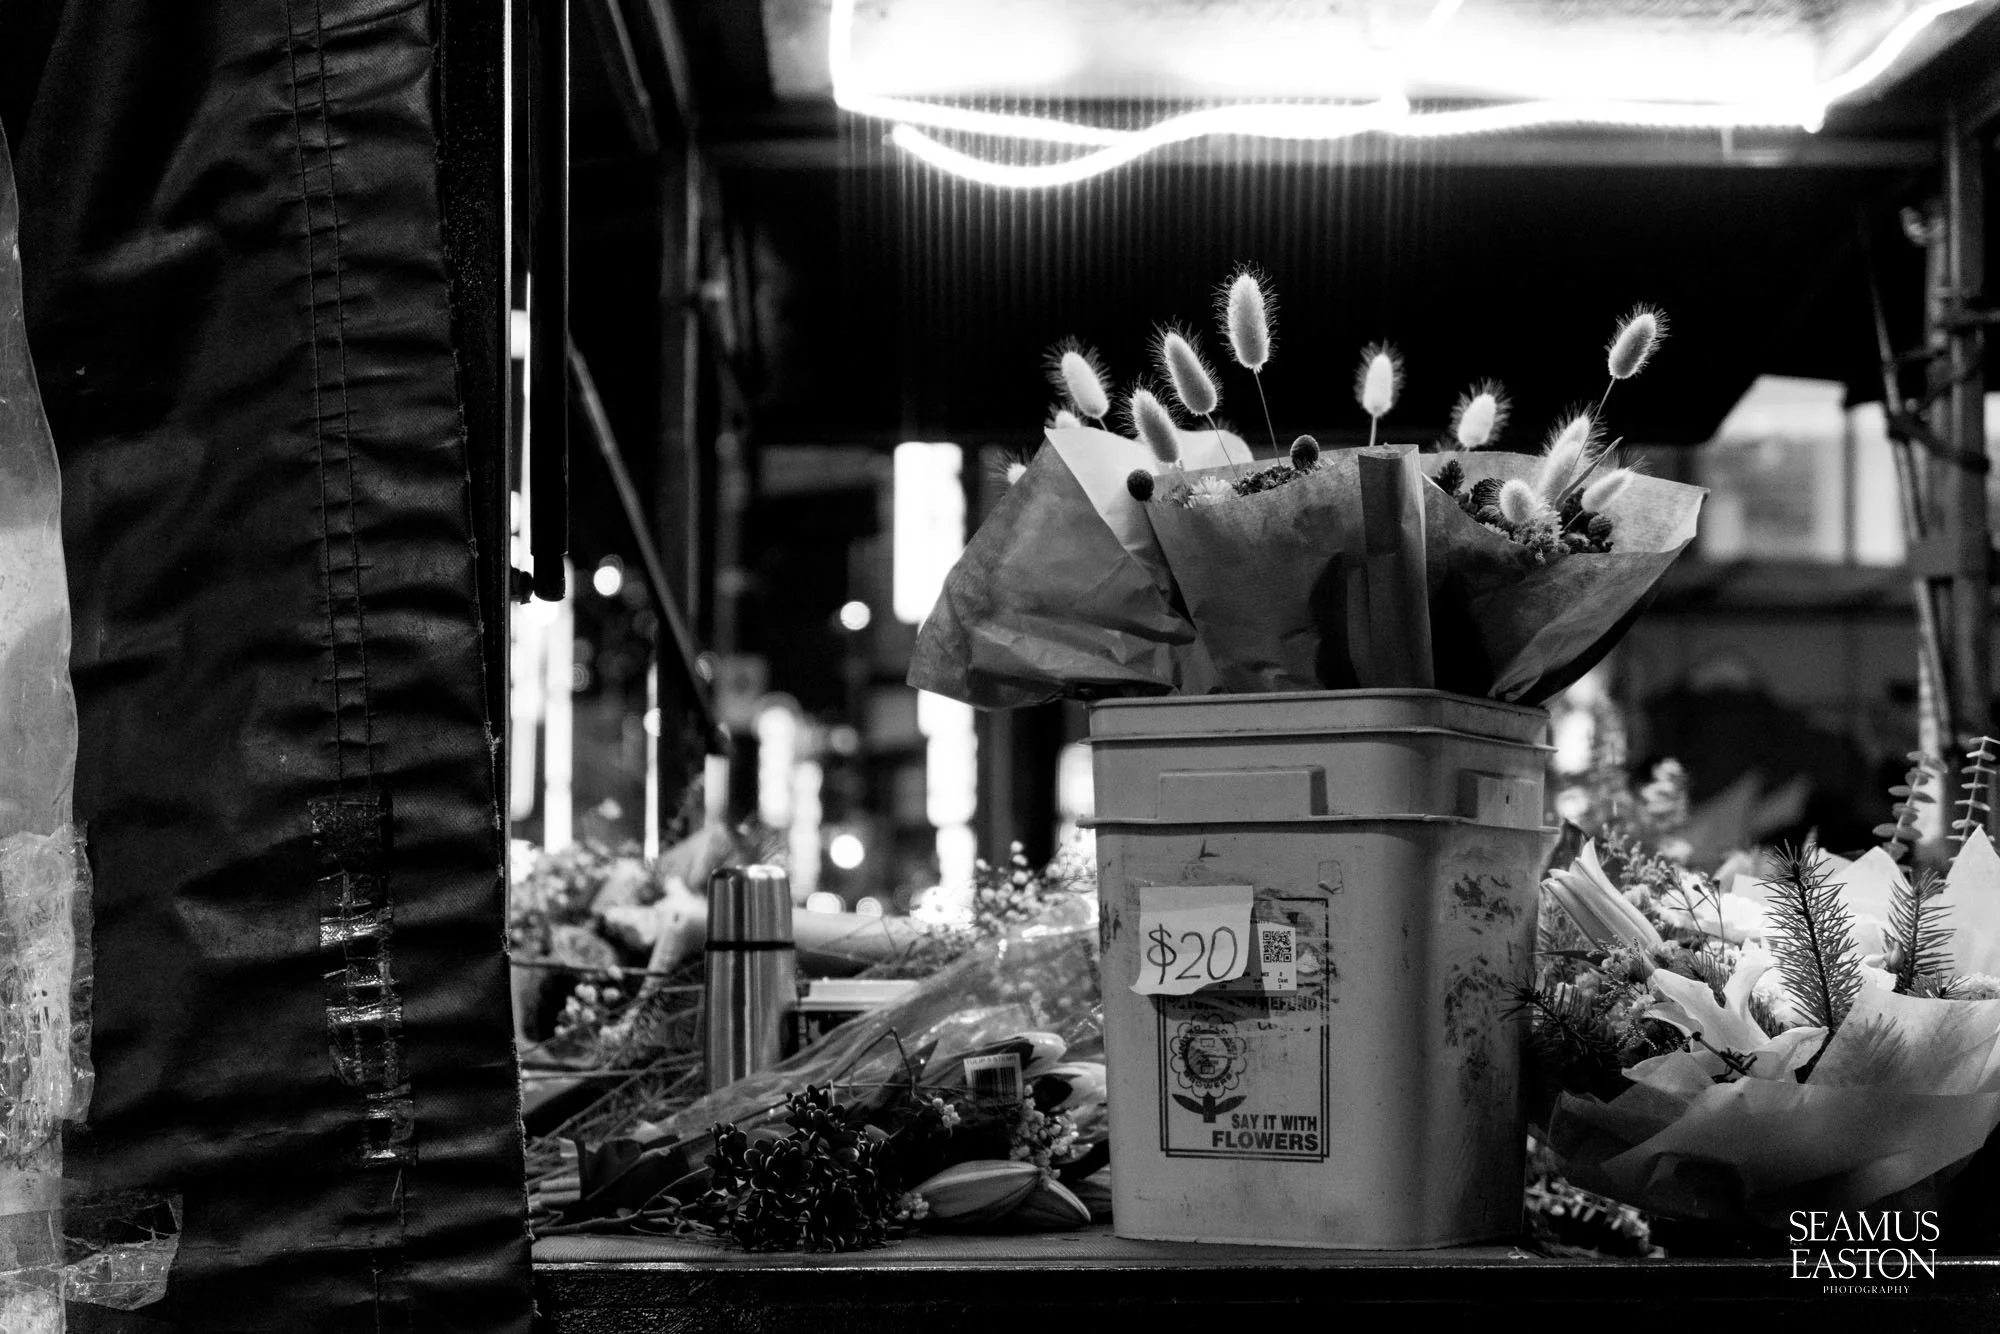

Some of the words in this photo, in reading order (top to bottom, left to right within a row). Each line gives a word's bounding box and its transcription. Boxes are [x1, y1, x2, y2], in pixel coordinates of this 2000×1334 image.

[1147, 923, 1238, 985] $20
[1231, 1113, 1259, 1129] SAY
[1263, 1114, 1277, 1130] IT
[1281, 1115, 1317, 1131] WITH
[1212, 1130, 1319, 1151] FLOWERS
